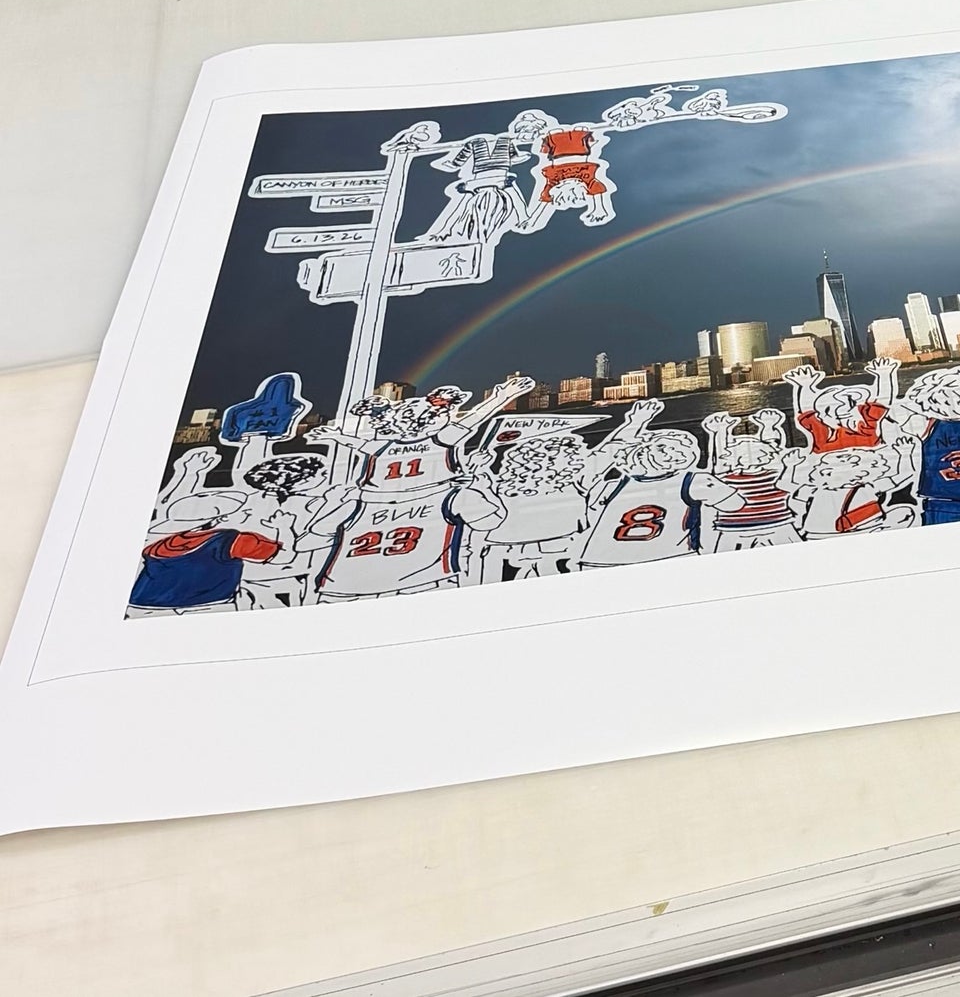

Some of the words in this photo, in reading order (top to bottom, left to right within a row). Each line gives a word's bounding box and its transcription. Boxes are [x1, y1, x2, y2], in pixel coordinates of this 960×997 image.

[263, 181, 317, 189] CANYON
[329, 196, 371, 205] MSG
[504, 420, 535, 429] NEW
[536, 419, 571, 430] YORK
[388, 444, 431, 456] ORANGE
[384, 458, 424, 480] 11
[372, 504, 434, 526] BLUE
[613, 504, 667, 541] 8
[346, 526, 424, 558] 23
